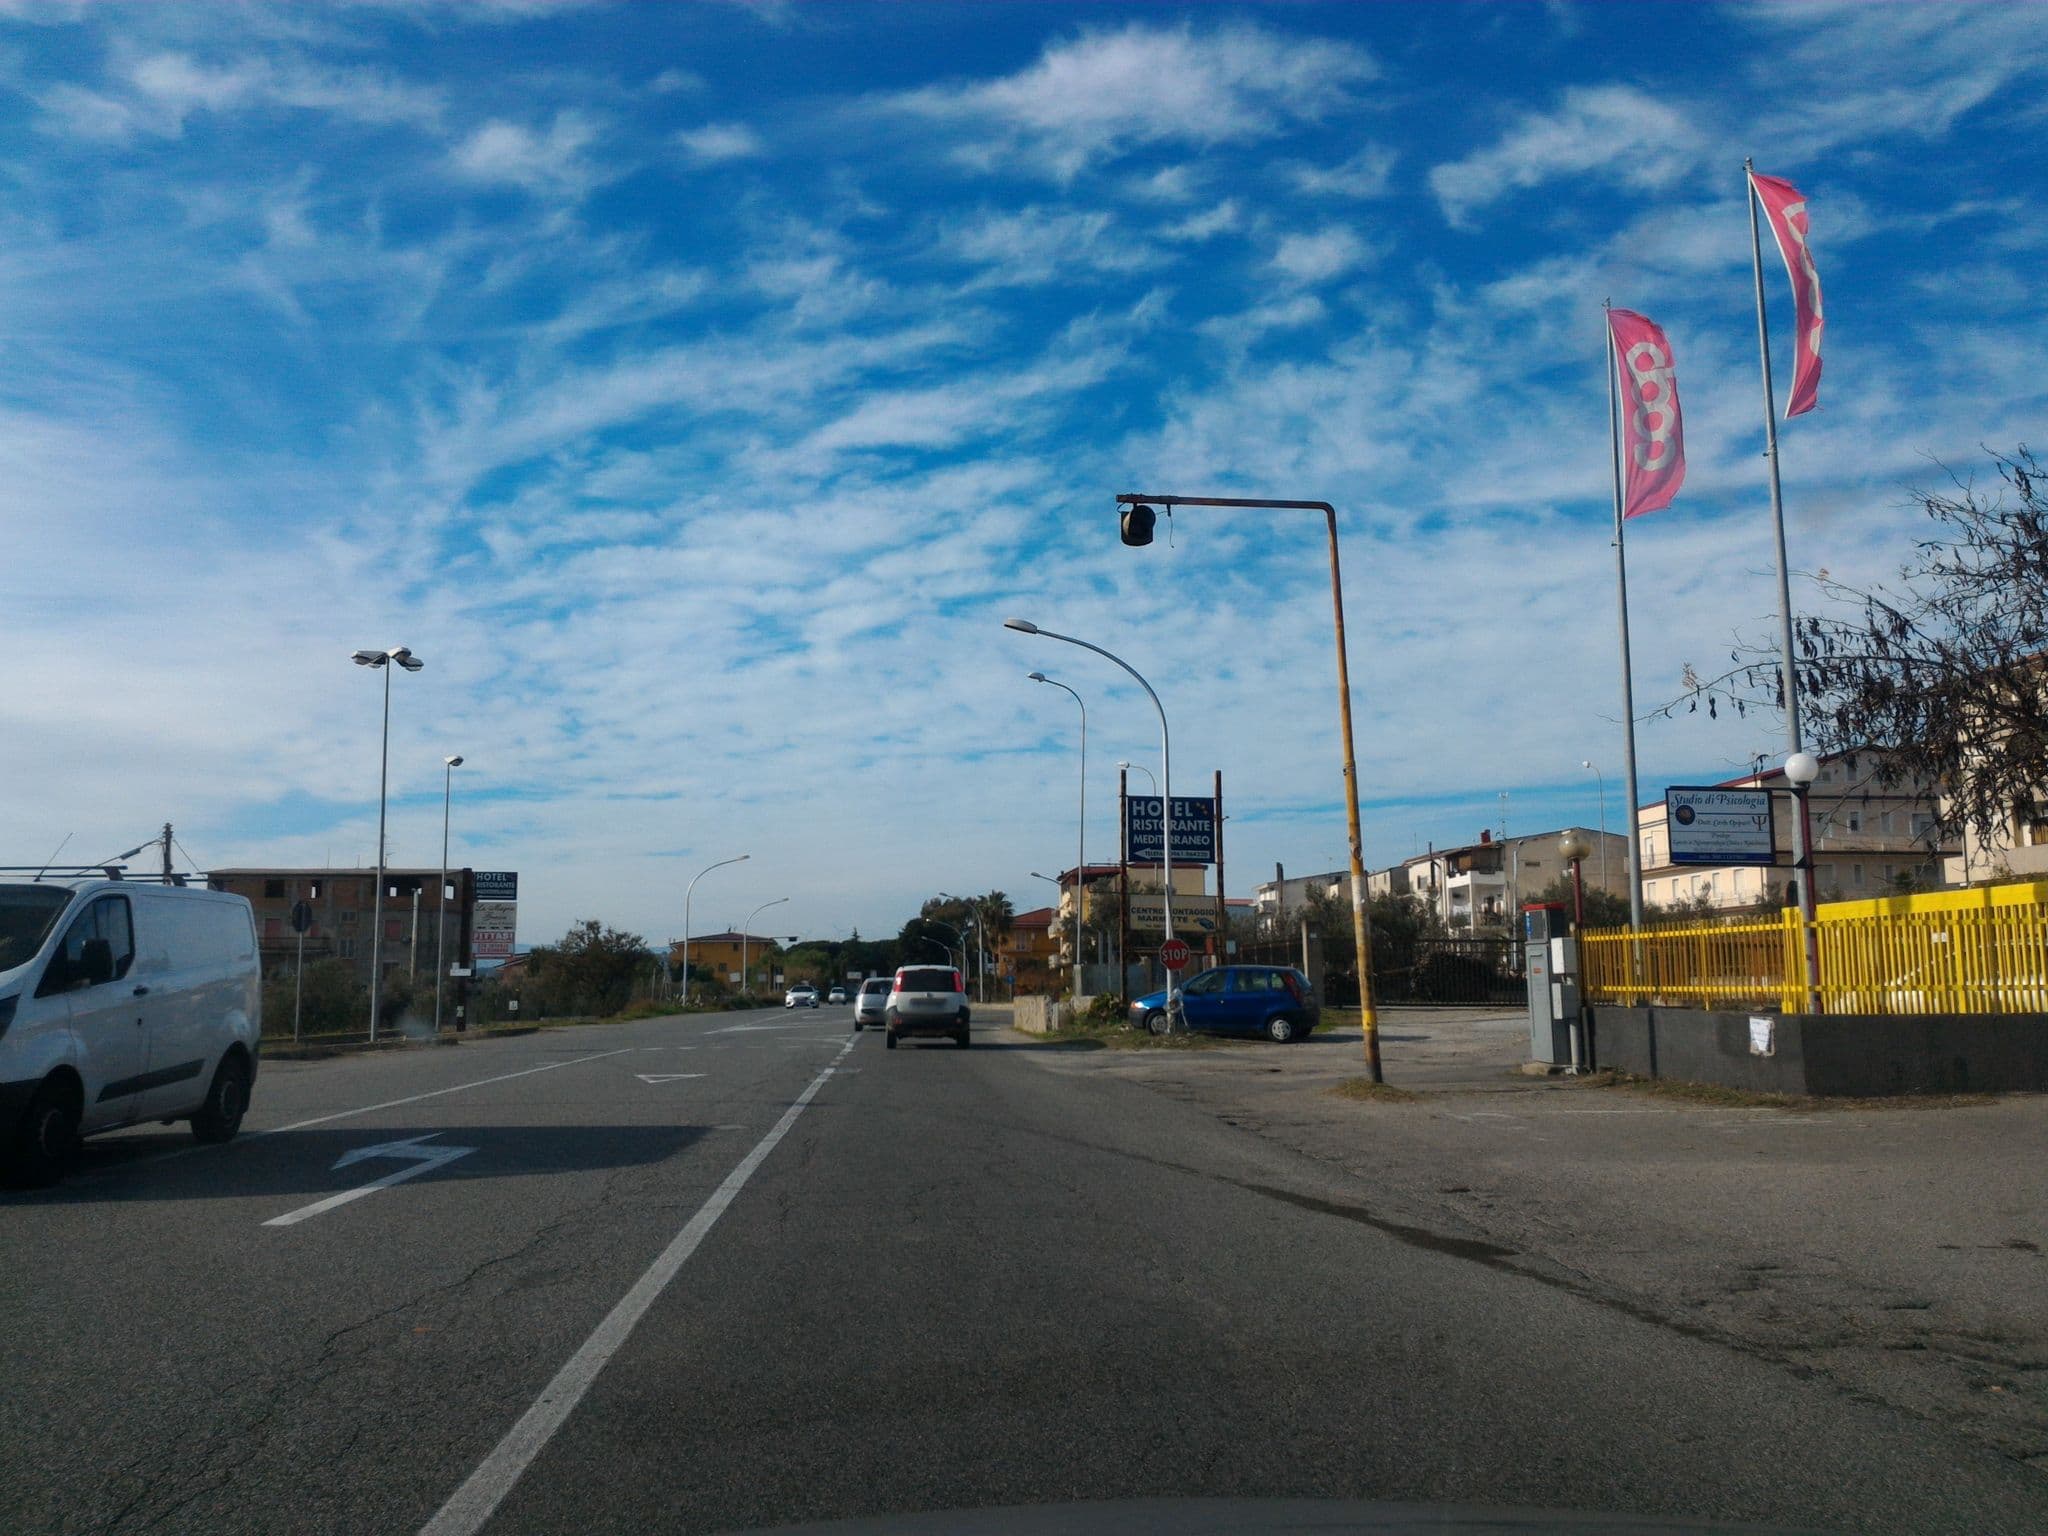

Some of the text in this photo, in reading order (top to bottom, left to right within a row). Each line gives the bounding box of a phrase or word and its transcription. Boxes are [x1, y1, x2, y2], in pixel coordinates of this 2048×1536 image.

[1671, 793, 1766, 809] Studio di Psicologia
[1132, 800, 1193, 817] HOEL
[1133, 834, 1210, 845] MEDITRRANEO
[476, 872, 507, 881] HOTEL
[1172, 907, 1215, 916] ONTAGGIO
[1161, 949, 1188, 961] STOP
